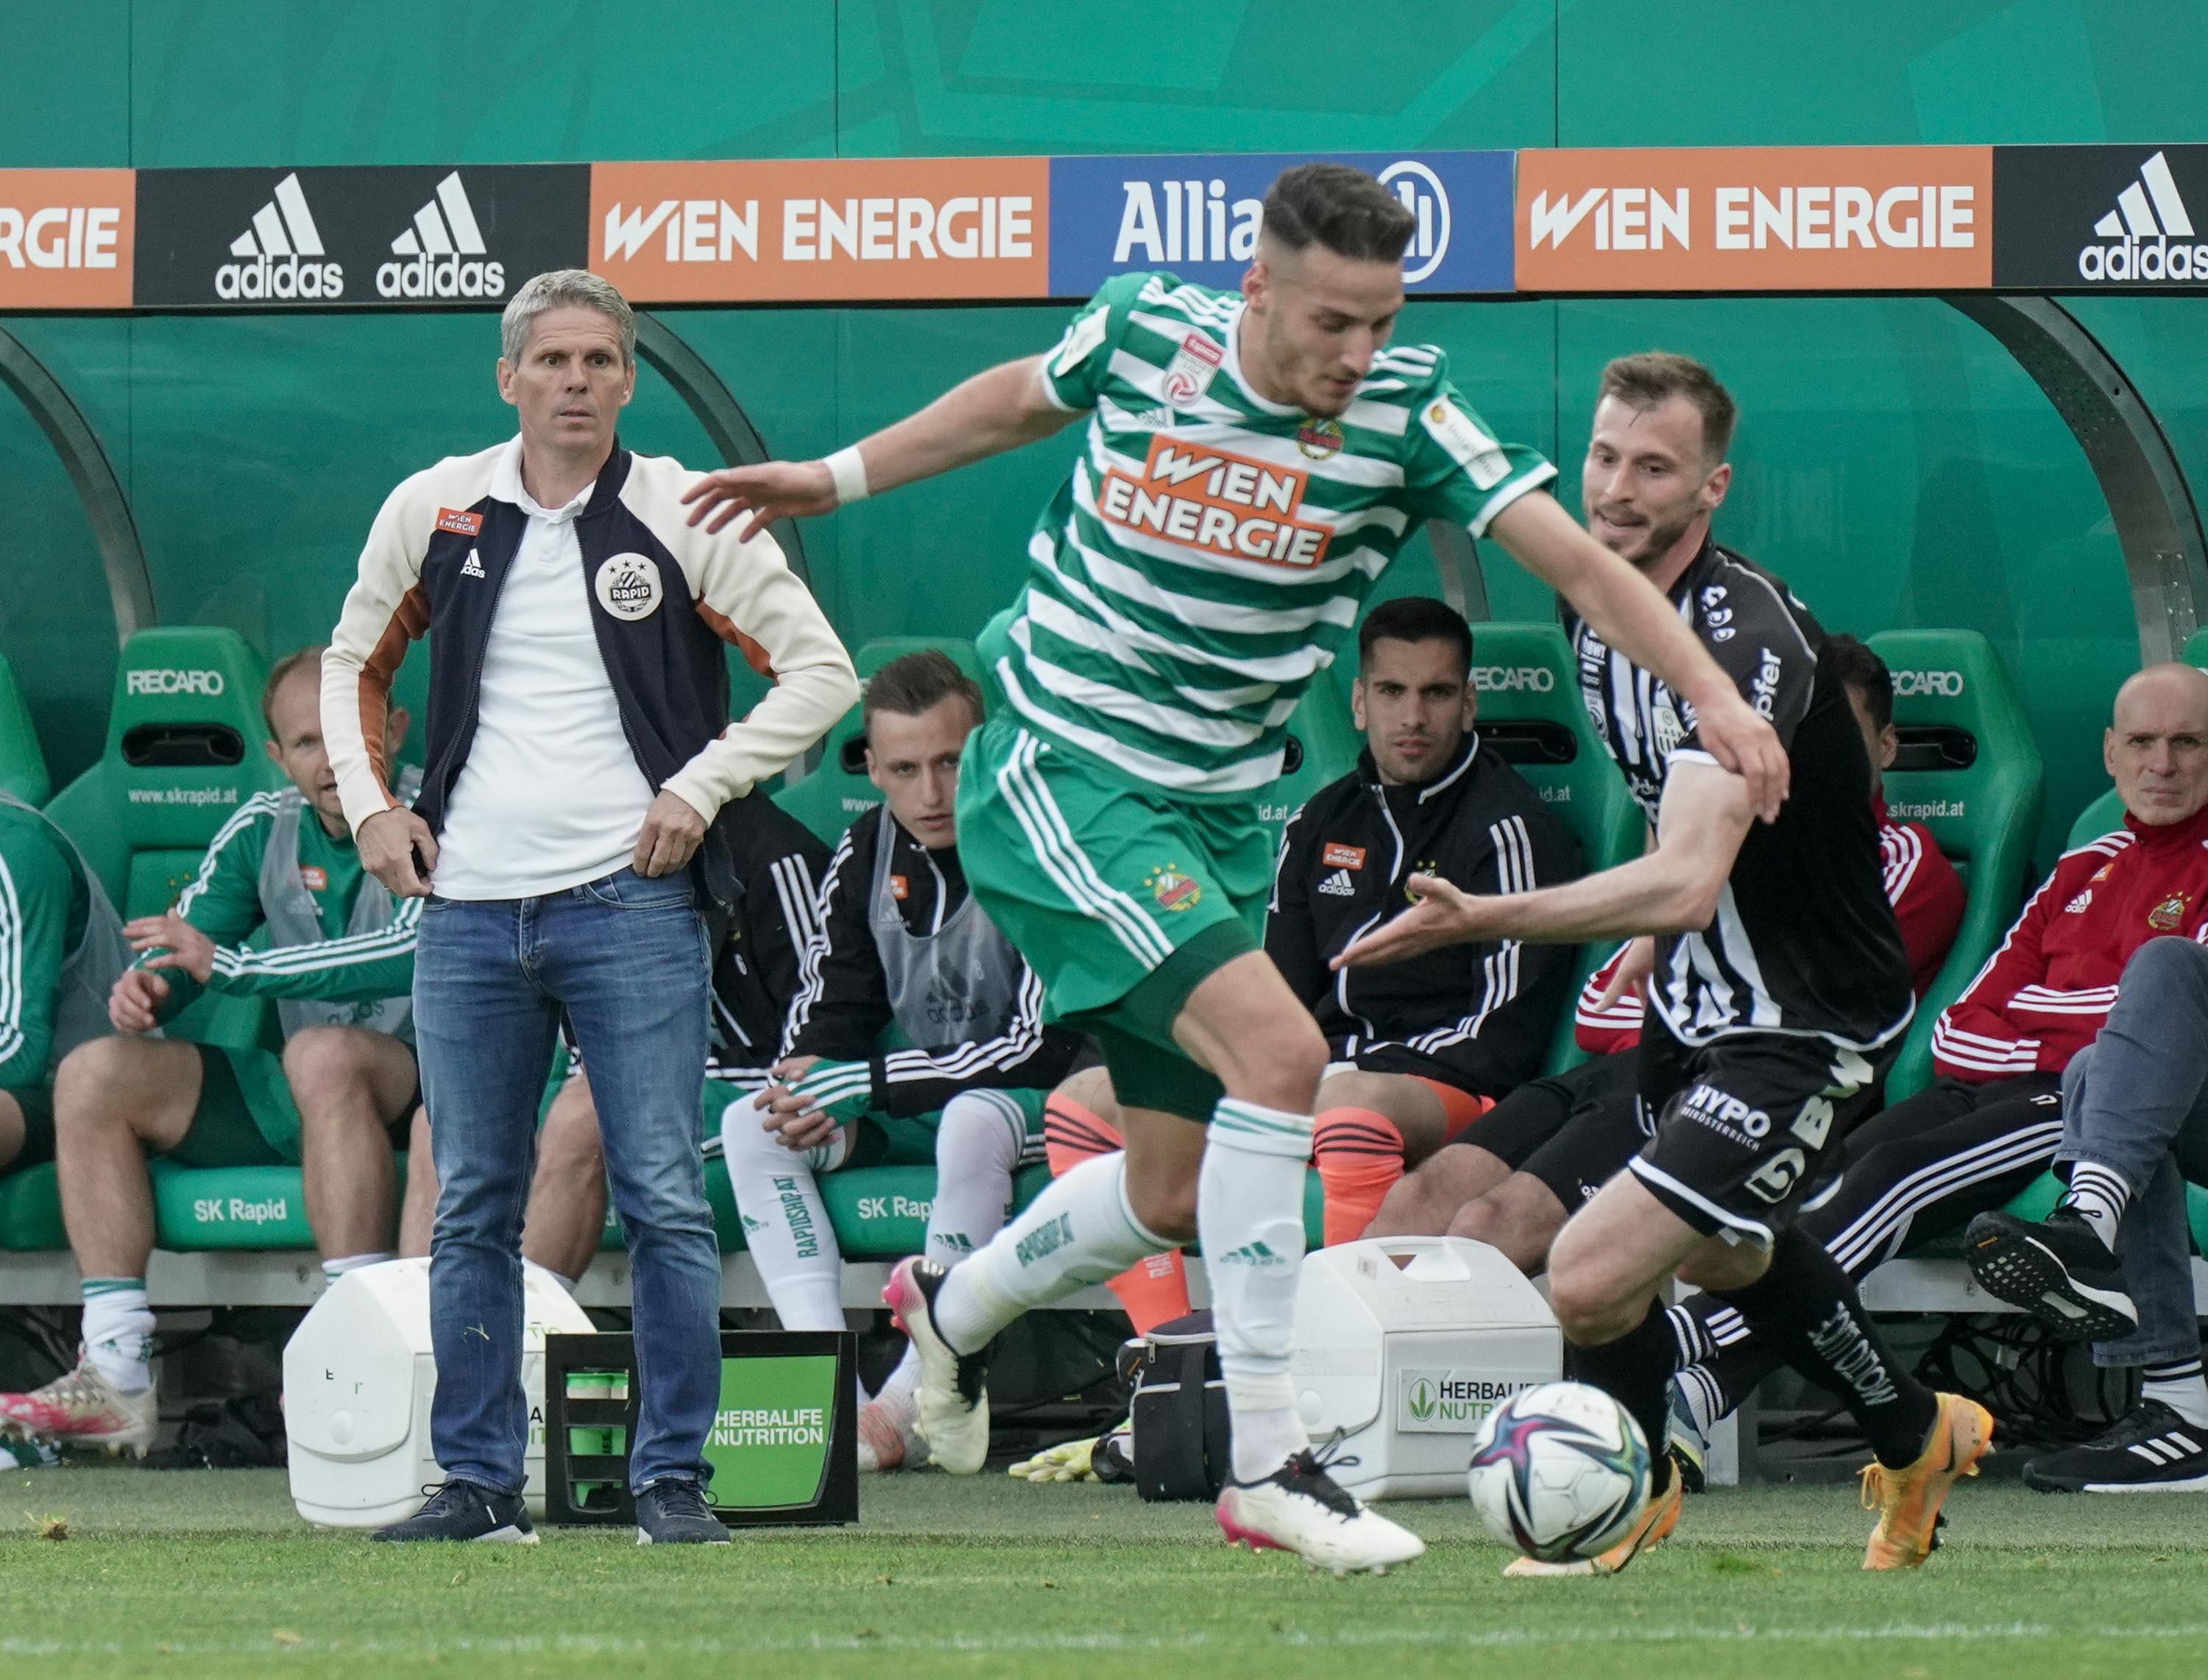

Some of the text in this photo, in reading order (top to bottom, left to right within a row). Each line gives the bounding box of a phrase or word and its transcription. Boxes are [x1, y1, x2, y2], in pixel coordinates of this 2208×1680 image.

[604, 196, 1033, 263] WIEN ENERGIE
[1530, 185, 1975, 251] WIEN ENERGIE
[2078, 235, 2208, 282] adidas
[215, 254, 344, 299] adidas
[376, 252, 506, 297] adidas
[1150, 446, 1298, 514] WIEN
[439, 520, 477, 532] ENERGIE
[448, 514, 472, 523] WIEN
[1104, 476, 1325, 565] ENERGIE
[612, 587, 650, 600] RAPID
[127, 669, 224, 696] RECARO
[127, 787, 238, 808] www.skrapid.at
[1318, 884, 1356, 896] adidas
[1686, 1084, 1772, 1138] HYPO
[193, 1198, 288, 1226] SK Rapid
[857, 1196, 935, 1223] SK Rap
[715, 1408, 824, 1428] HERBALIFE
[714, 1426, 824, 1447] NUTRITION
